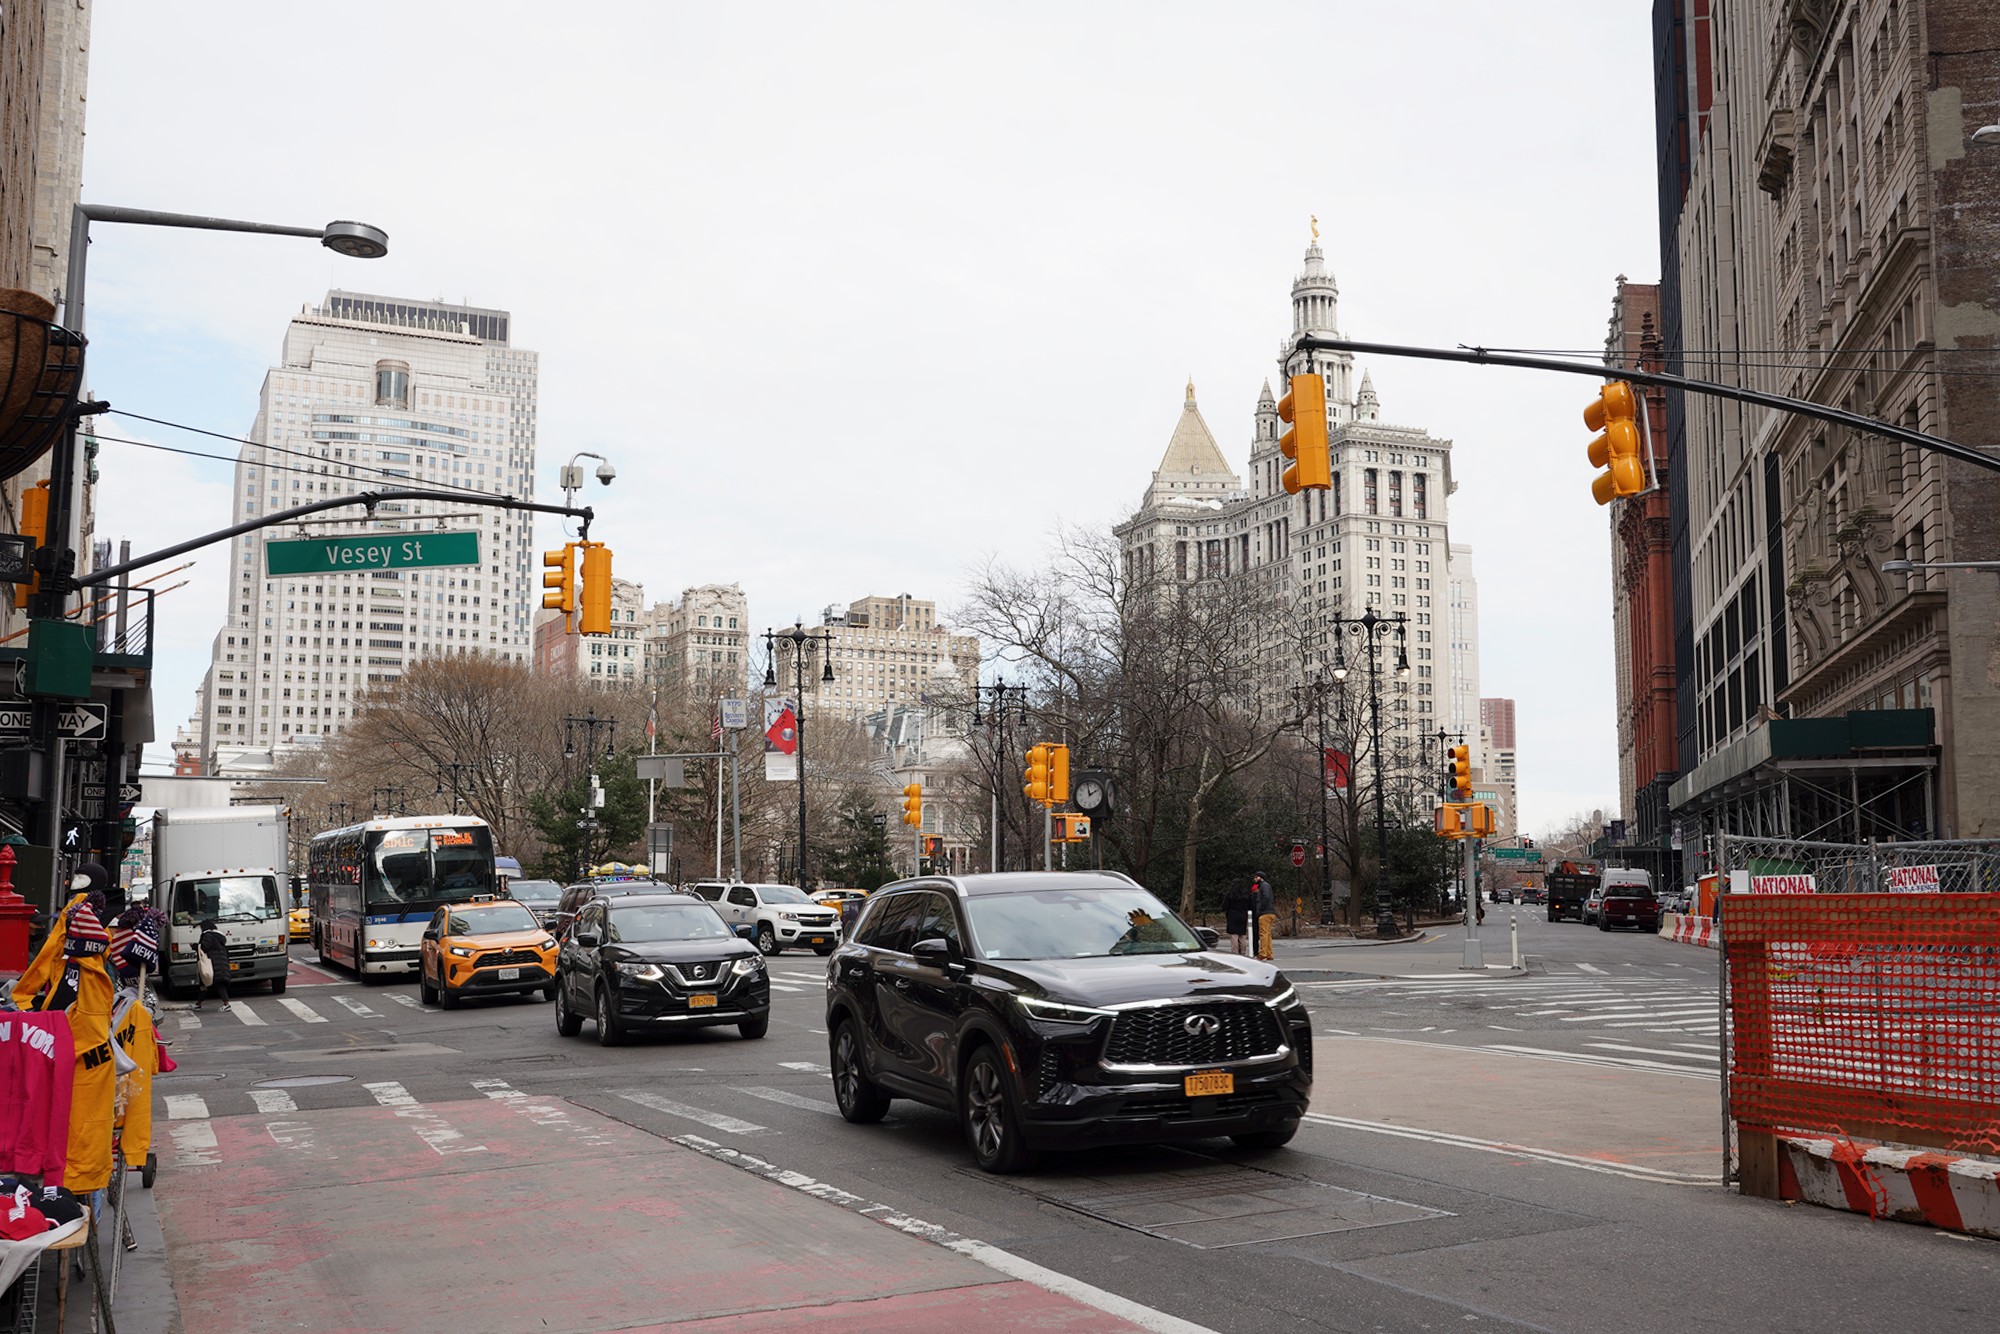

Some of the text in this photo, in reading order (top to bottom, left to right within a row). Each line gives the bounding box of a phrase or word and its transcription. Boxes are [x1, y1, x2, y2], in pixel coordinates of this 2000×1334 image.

[326, 541, 423, 567] Vesey St
[0, 713, 32, 726] ONE
[86, 788, 105, 796] ONE
[1292, 851, 1304, 860] STOP
[1890, 866, 1938, 887] NATIONAL
[1752, 876, 1814, 894] NATIONAL
[1891, 883, 1938, 893] RENT-A-FENCE
[84, 940, 106, 953] NEW
[131, 942, 153, 960] NEW
